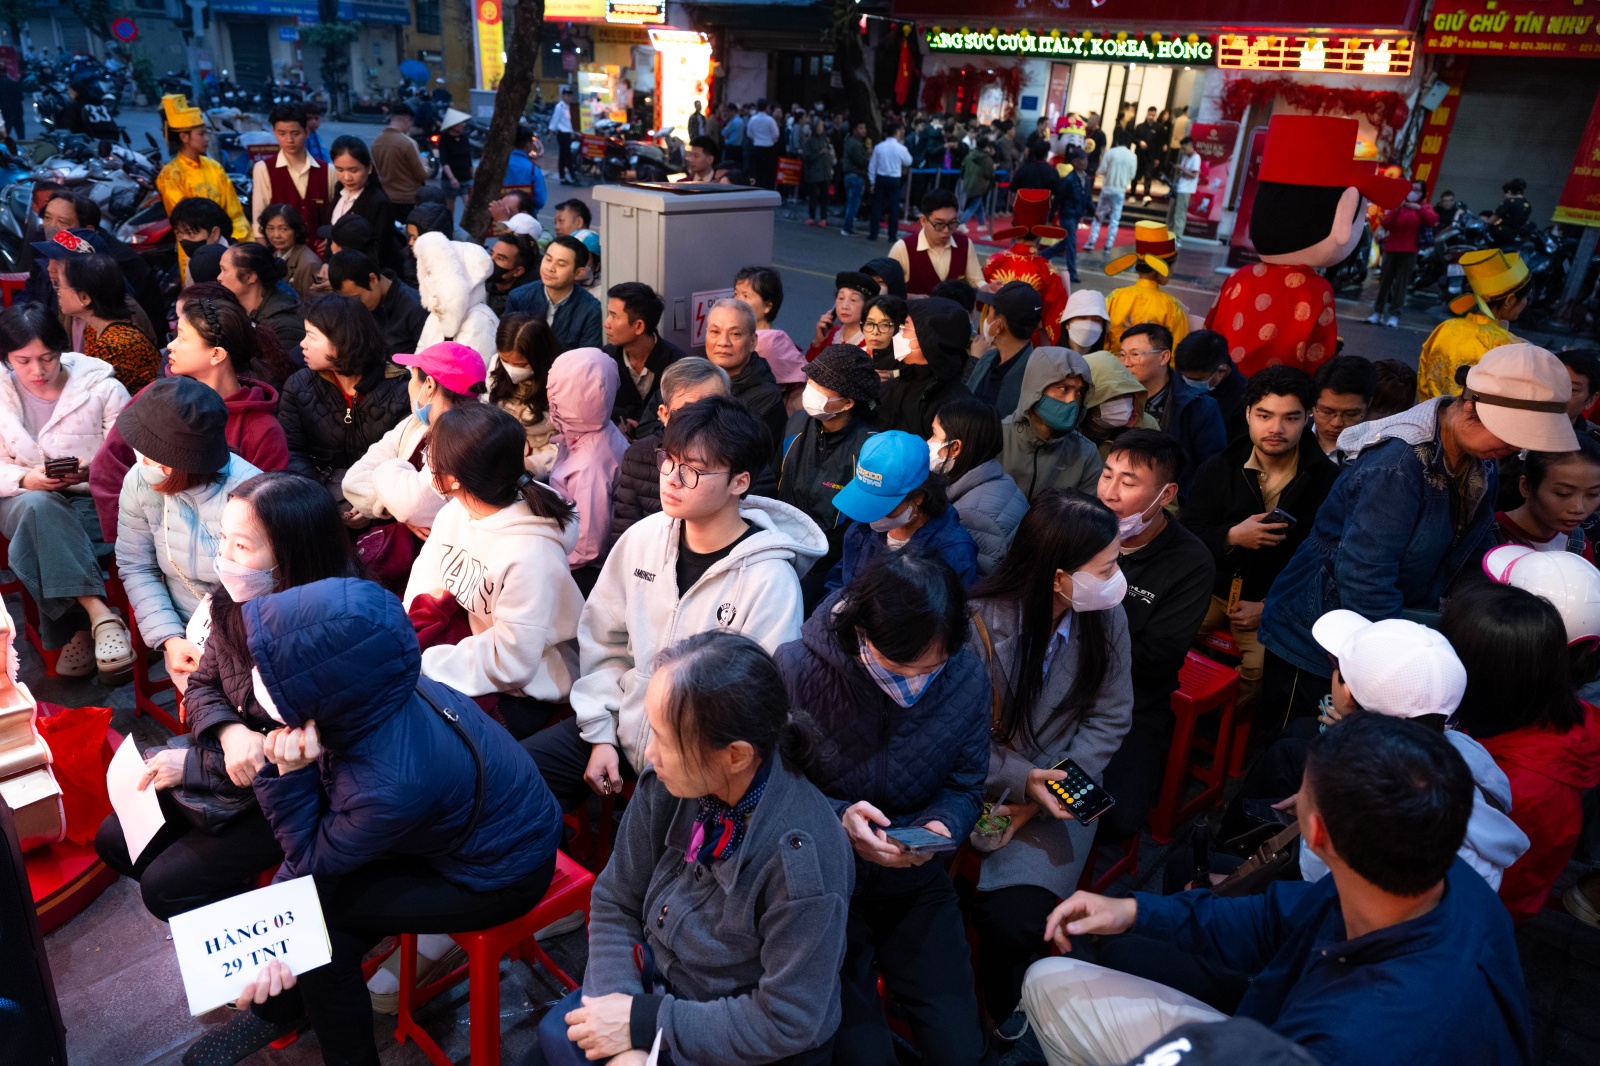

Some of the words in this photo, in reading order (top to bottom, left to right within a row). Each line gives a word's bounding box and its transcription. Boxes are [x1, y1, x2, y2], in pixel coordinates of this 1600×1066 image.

[1433, 9, 1467, 32] GIỮ
[1468, 10, 1510, 33] CHỮ
[1513, 10, 1545, 34] TÍN
[1090, 38, 1155, 60] KOREA,
[204, 919, 269, 955] HÀNG
[273, 911, 295, 929] 03
[221, 957, 243, 978] 29
[246, 938, 291, 966] TNT
